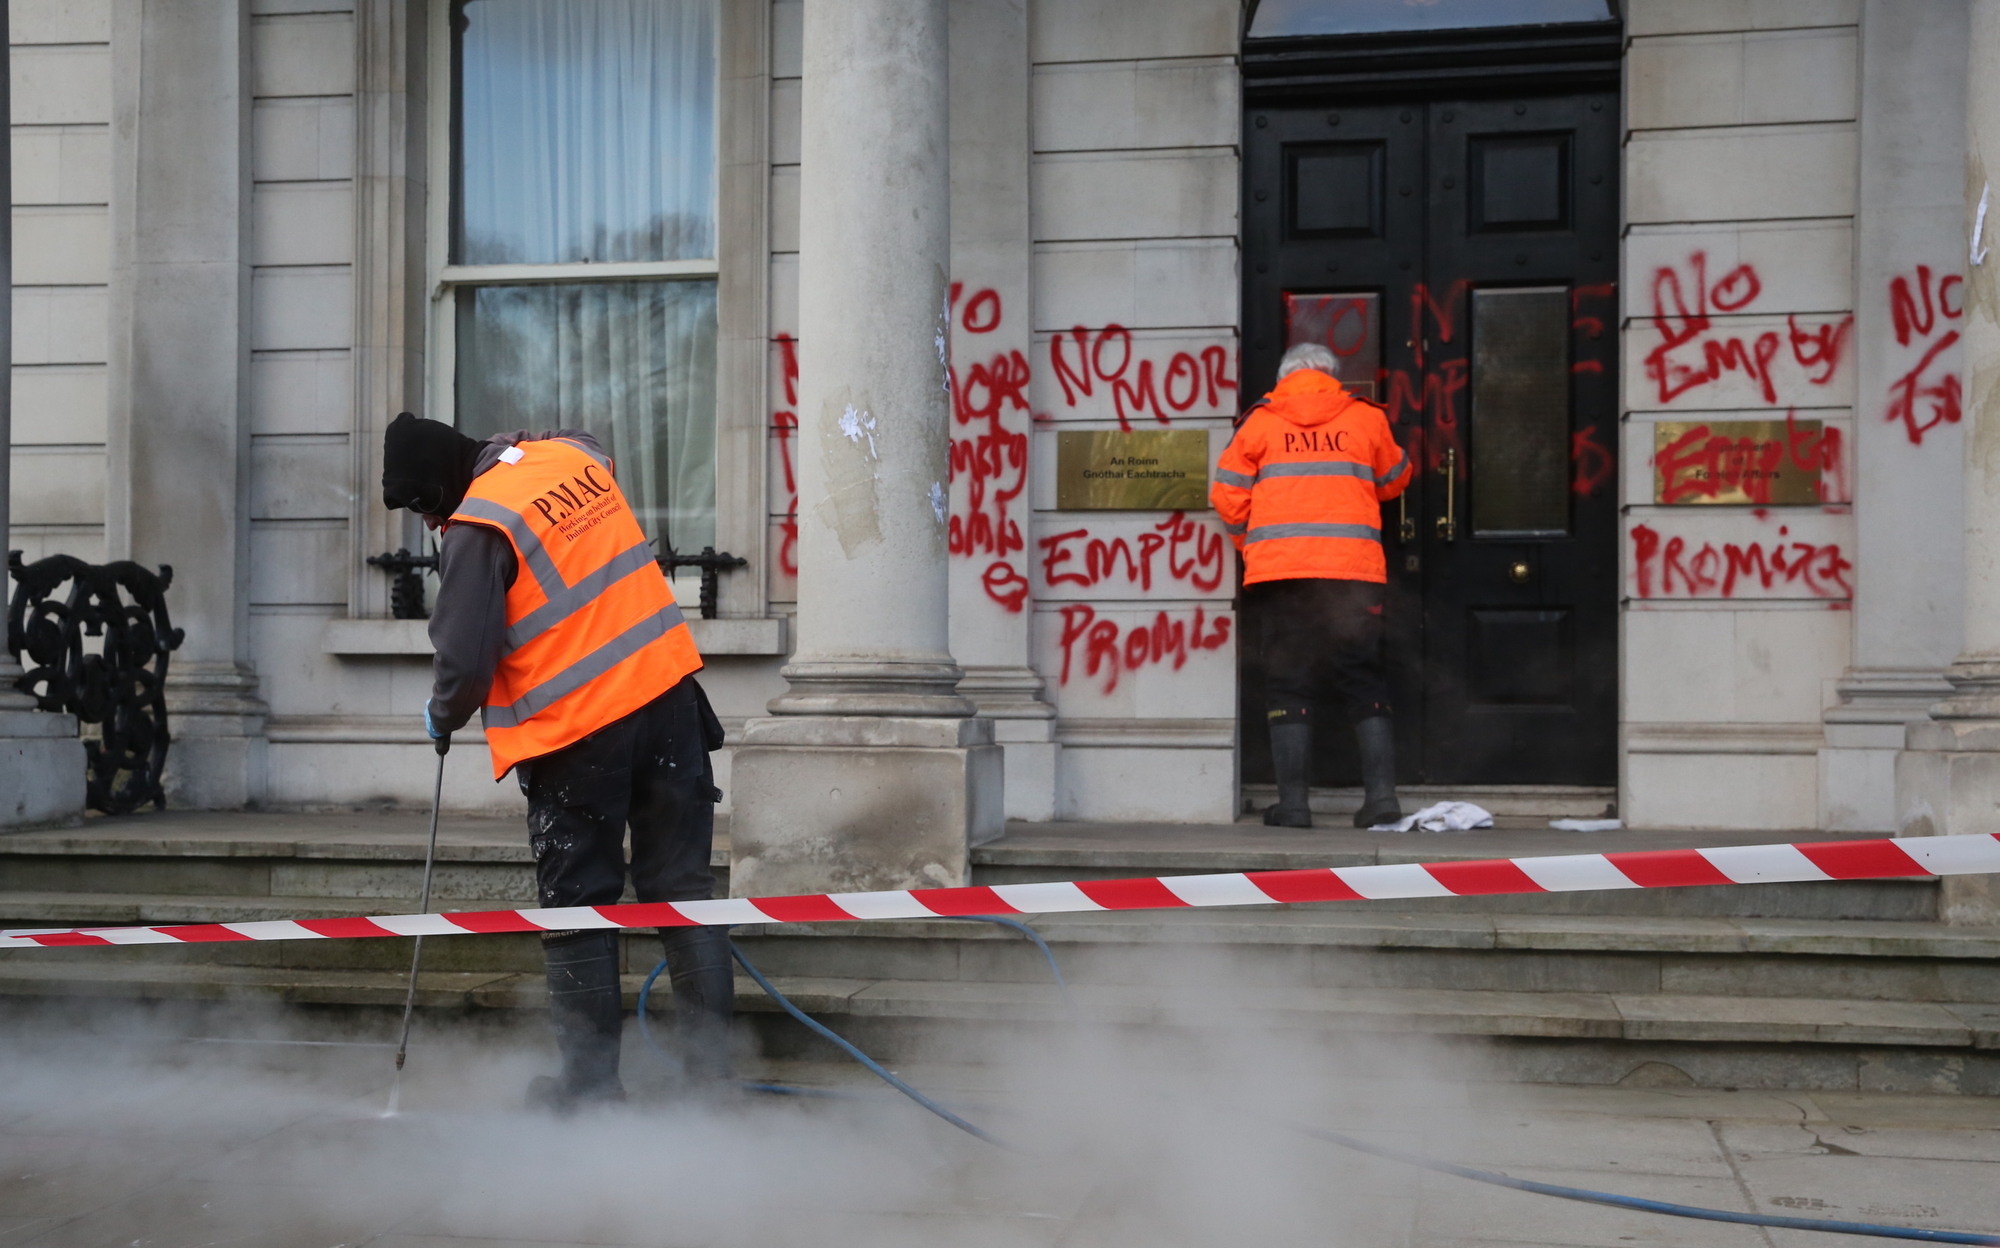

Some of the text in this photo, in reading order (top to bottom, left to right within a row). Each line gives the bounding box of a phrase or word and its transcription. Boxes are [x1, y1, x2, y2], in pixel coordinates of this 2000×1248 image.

[1050, 323, 1132, 408] NO
[1284, 430, 1349, 453] P.MAC
[1110, 456, 1159, 466] An Roinn
[1127, 468, 1186, 479] Eachtracha
[531, 464, 611, 528] P.MAC
[558, 514, 588, 534] Working
[591, 496, 612, 512] behalf
[565, 502, 622, 542] Dublin City Council
